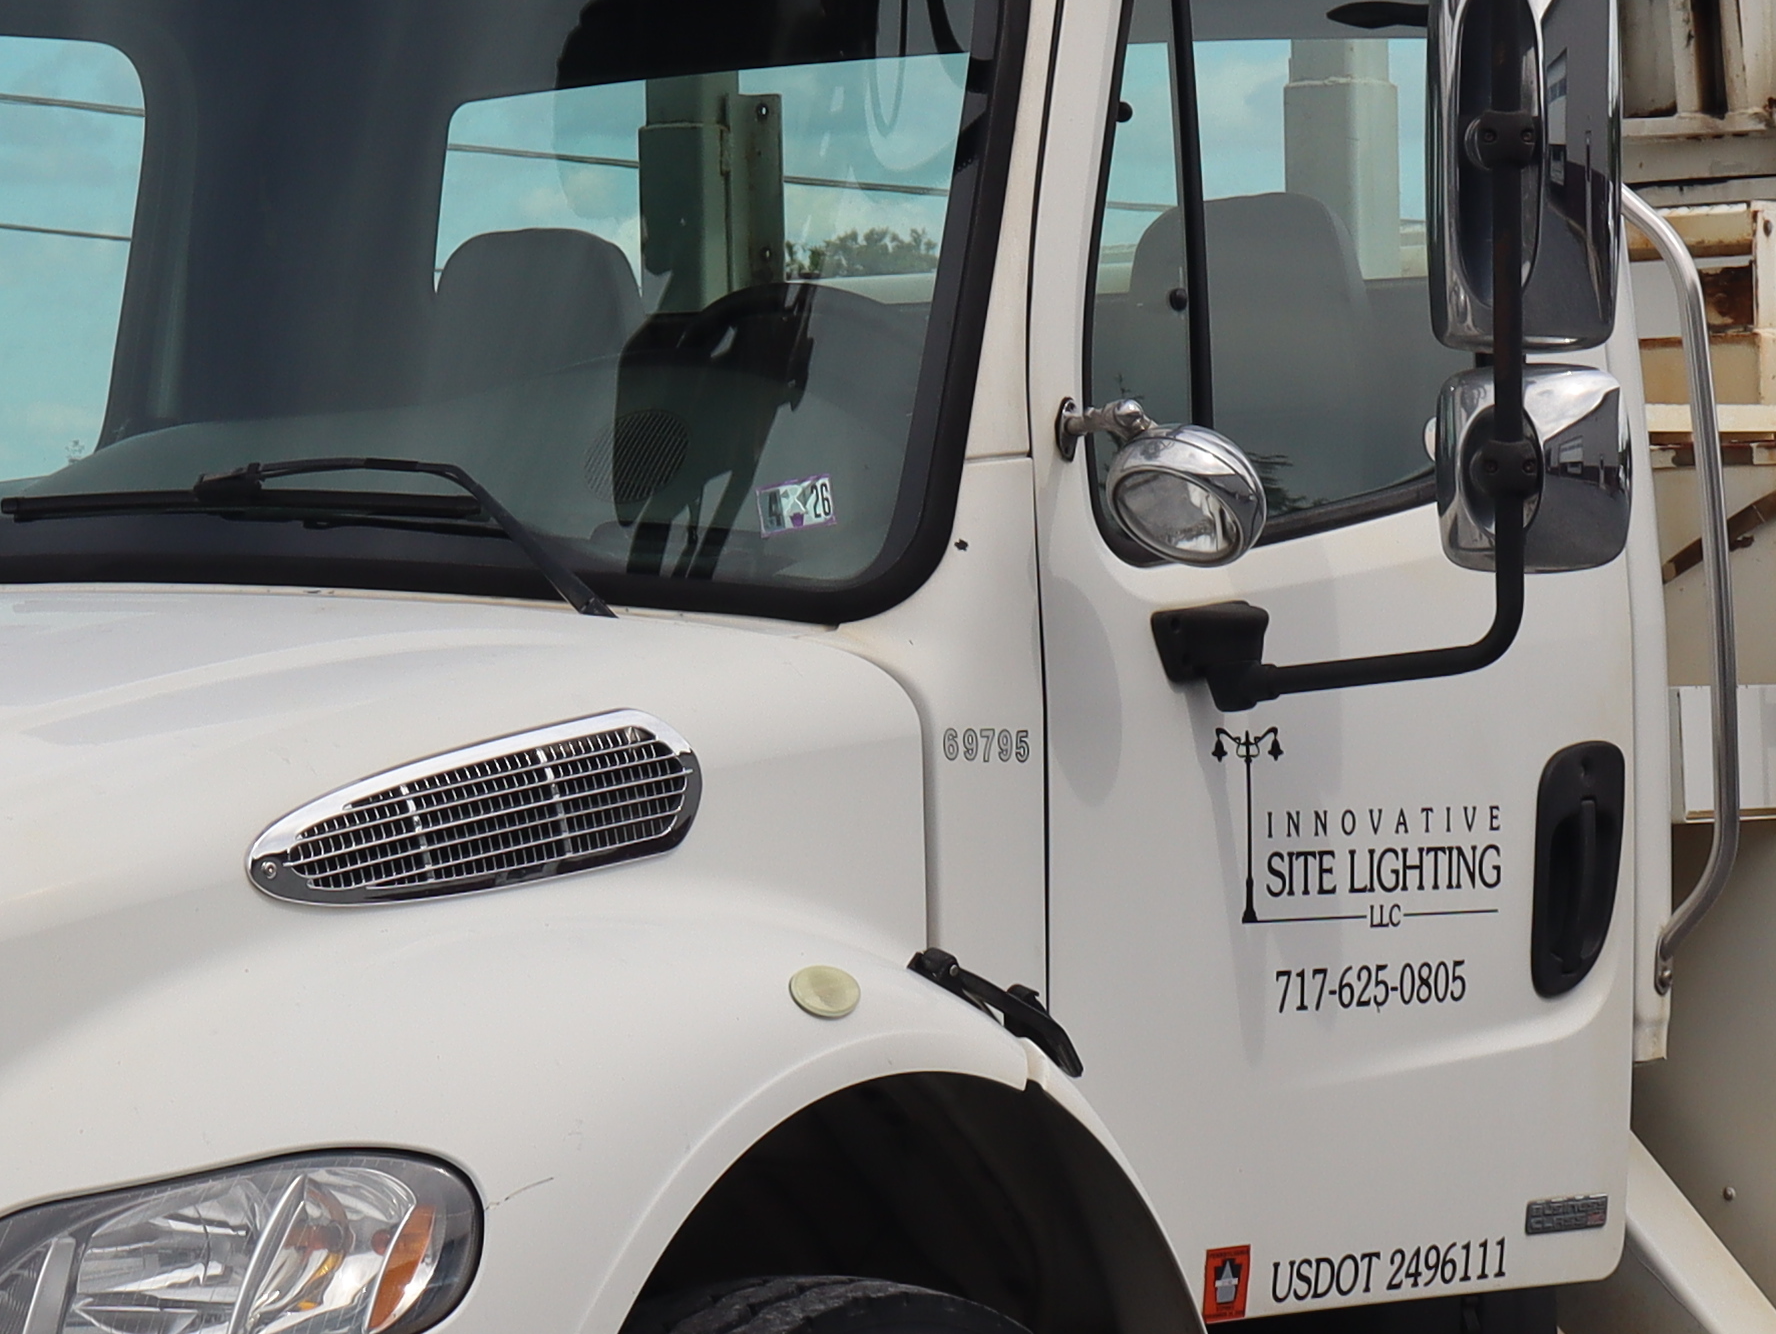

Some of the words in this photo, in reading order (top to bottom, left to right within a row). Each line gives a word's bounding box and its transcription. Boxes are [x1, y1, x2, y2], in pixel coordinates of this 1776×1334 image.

[811, 483, 832, 518] 26
[943, 728, 1030, 763] 69795
[1267, 805, 1501, 838] INNOVATIVE
[1266, 850, 1337, 898] SITE
[1348, 844, 1502, 893] LIGHTING
[1369, 903, 1401, 928] LLC
[1276, 960, 1466, 1013] 717-625-0805
[1272, 1251, 1381, 1303] USDOT
[1386, 1236, 1506, 1291] 2496111
